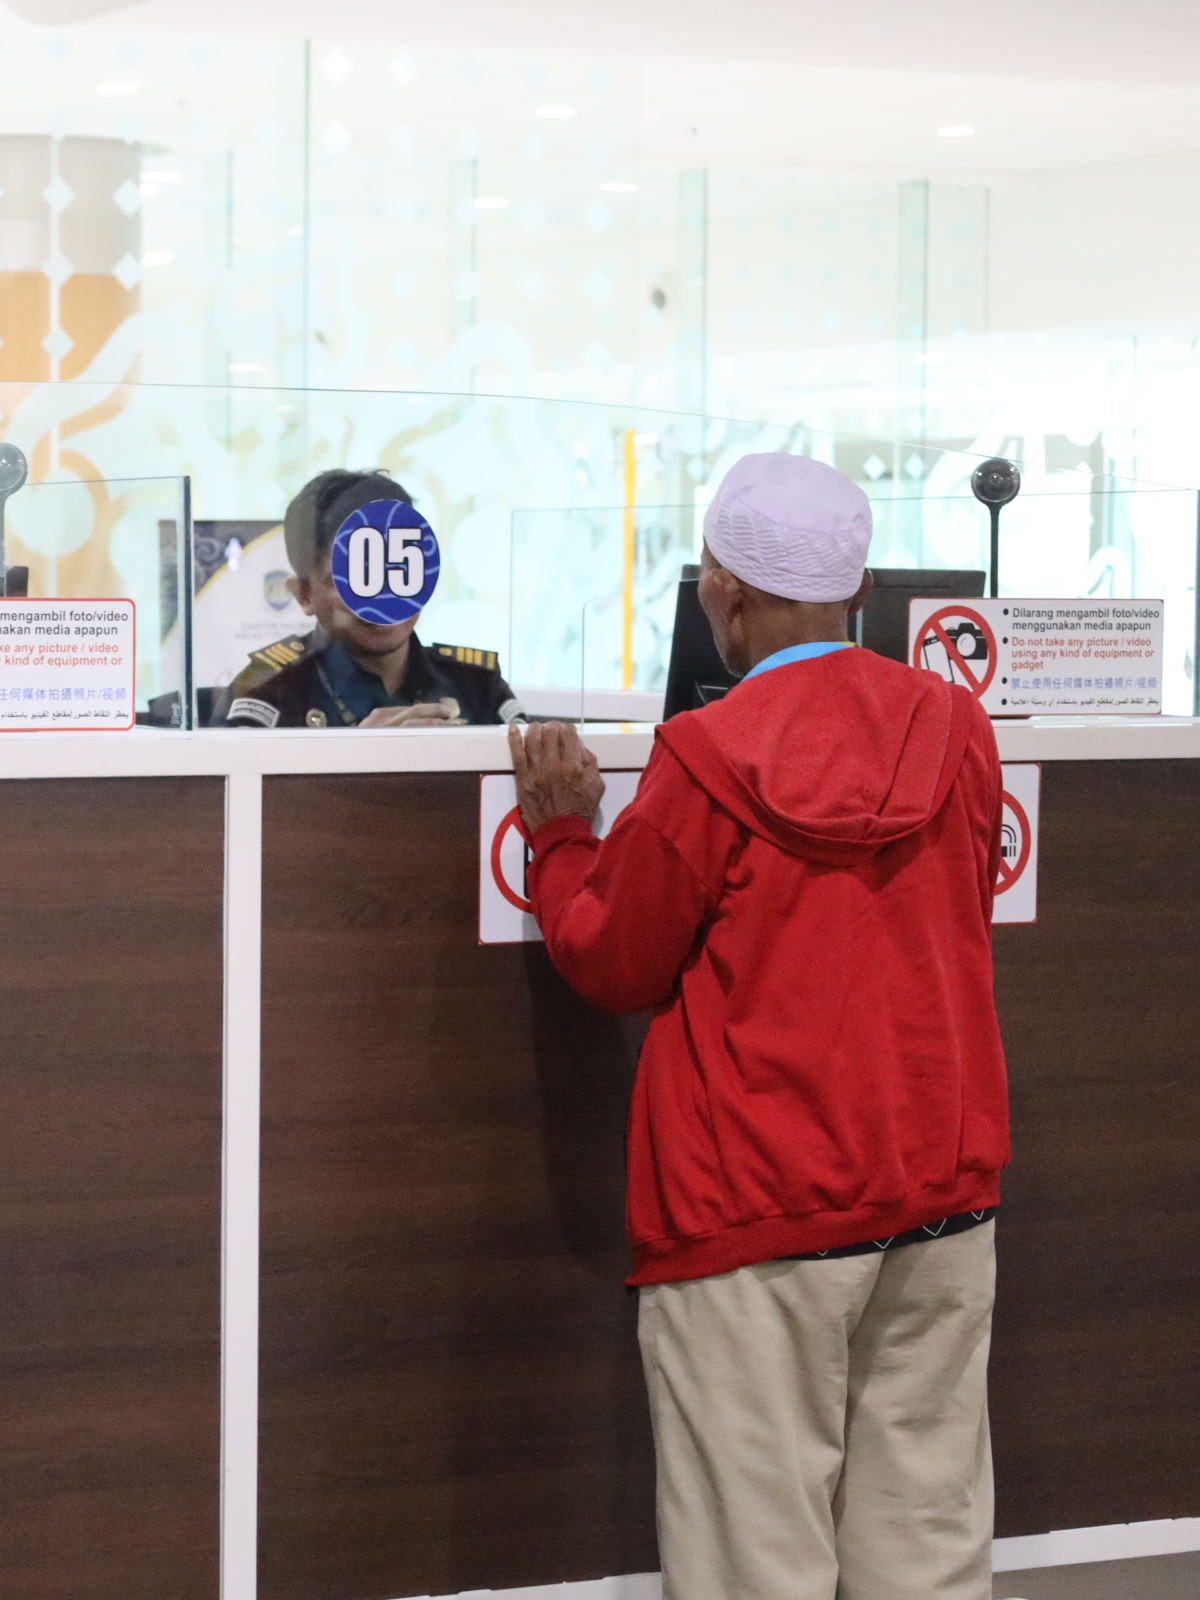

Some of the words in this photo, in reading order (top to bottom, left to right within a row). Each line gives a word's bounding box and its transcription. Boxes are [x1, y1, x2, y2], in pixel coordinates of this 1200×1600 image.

[348, 526, 425, 598] 05
[0, 610, 66, 623] mengambil
[69, 610, 129, 623] foto/video
[1012, 607, 1054, 621] Dilarang
[1056, 607, 1111, 621] mengambil
[1112, 607, 1160, 619] foto/video
[34, 624, 71, 636] media
[74, 625, 118, 638] apapun
[1012, 620, 1082, 632] menggunakan
[1084, 620, 1114, 631] media
[1116, 621, 1151, 632] apapun
[1011, 636, 1025, 647] Do
[1027, 637, 1043, 647] not
[1045, 636, 1066, 647] take
[1068, 638, 1085, 649] any
[1086, 637, 1119, 649] picture
[1126, 637, 1152, 647] video
[14, 644, 36, 657] any
[38, 642, 78, 657] picture
[88, 642, 119, 654] video
[1011, 649, 1038, 660] using
[1040, 649, 1057, 660] any
[1059, 648, 1080, 658] kind
[1082, 648, 1092, 658] of
[1093, 649, 1143, 660] equipment
[1144, 649, 1155, 658] or
[5, 655, 30, 666] kind
[33, 655, 45, 667] of
[47, 656, 108, 669] equipment
[111, 657, 123, 667] or
[1011, 660, 1044, 672] gadget
